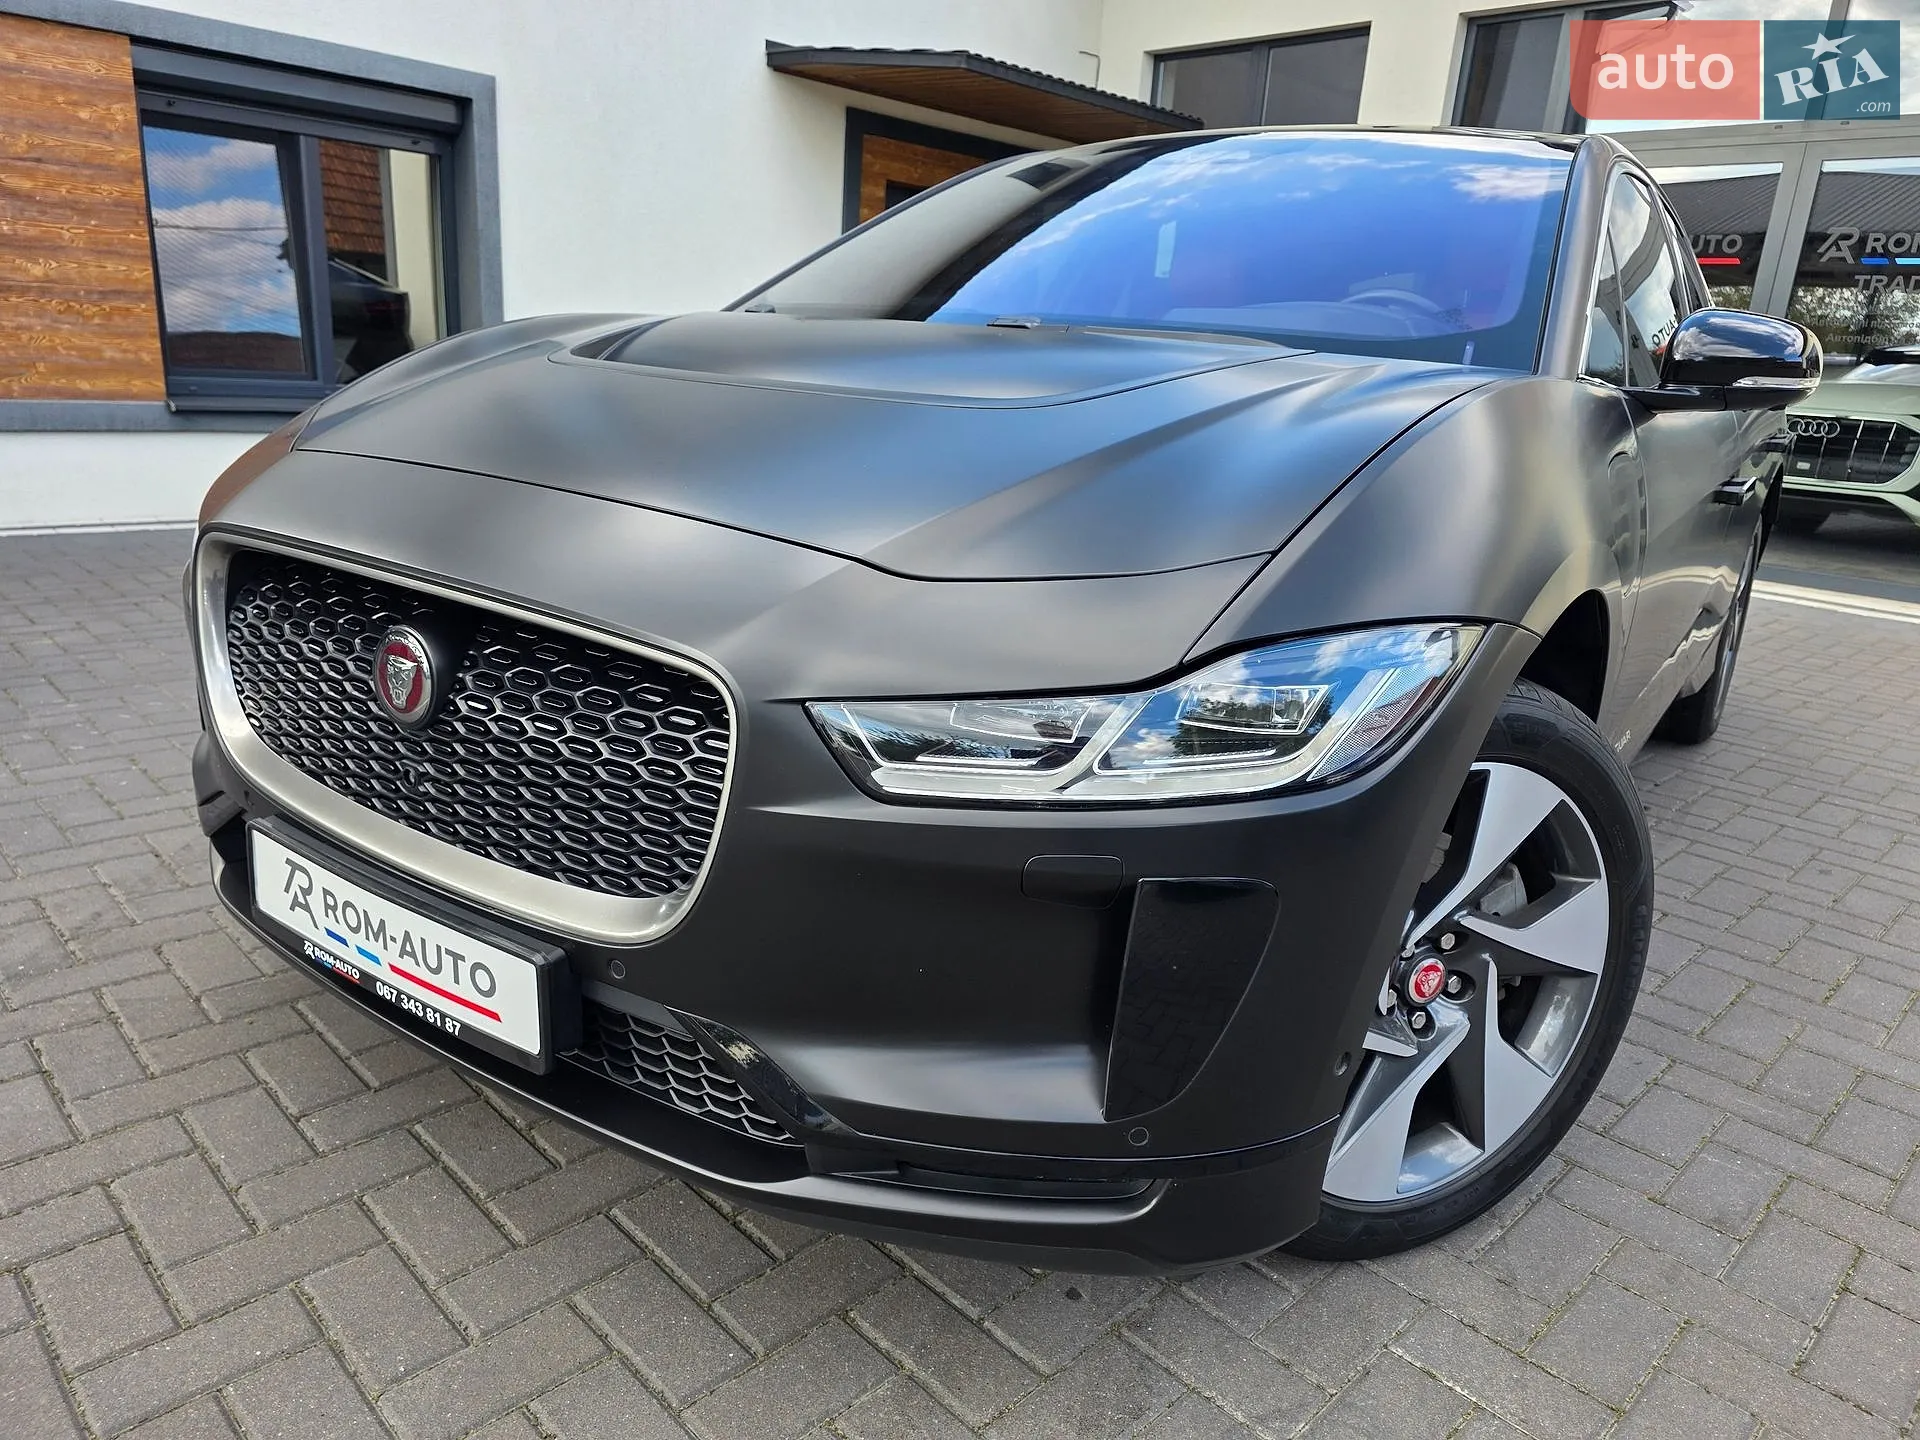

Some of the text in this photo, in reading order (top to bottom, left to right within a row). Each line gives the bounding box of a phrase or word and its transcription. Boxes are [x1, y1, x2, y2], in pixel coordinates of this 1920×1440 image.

[1690, 234, 1743, 254] UTO
[315, 947, 361, 980] ROM-AUTO
[322, 886, 497, 998] ROM-AUTO
[375, 981, 461, 1037] 067 343 81 87
